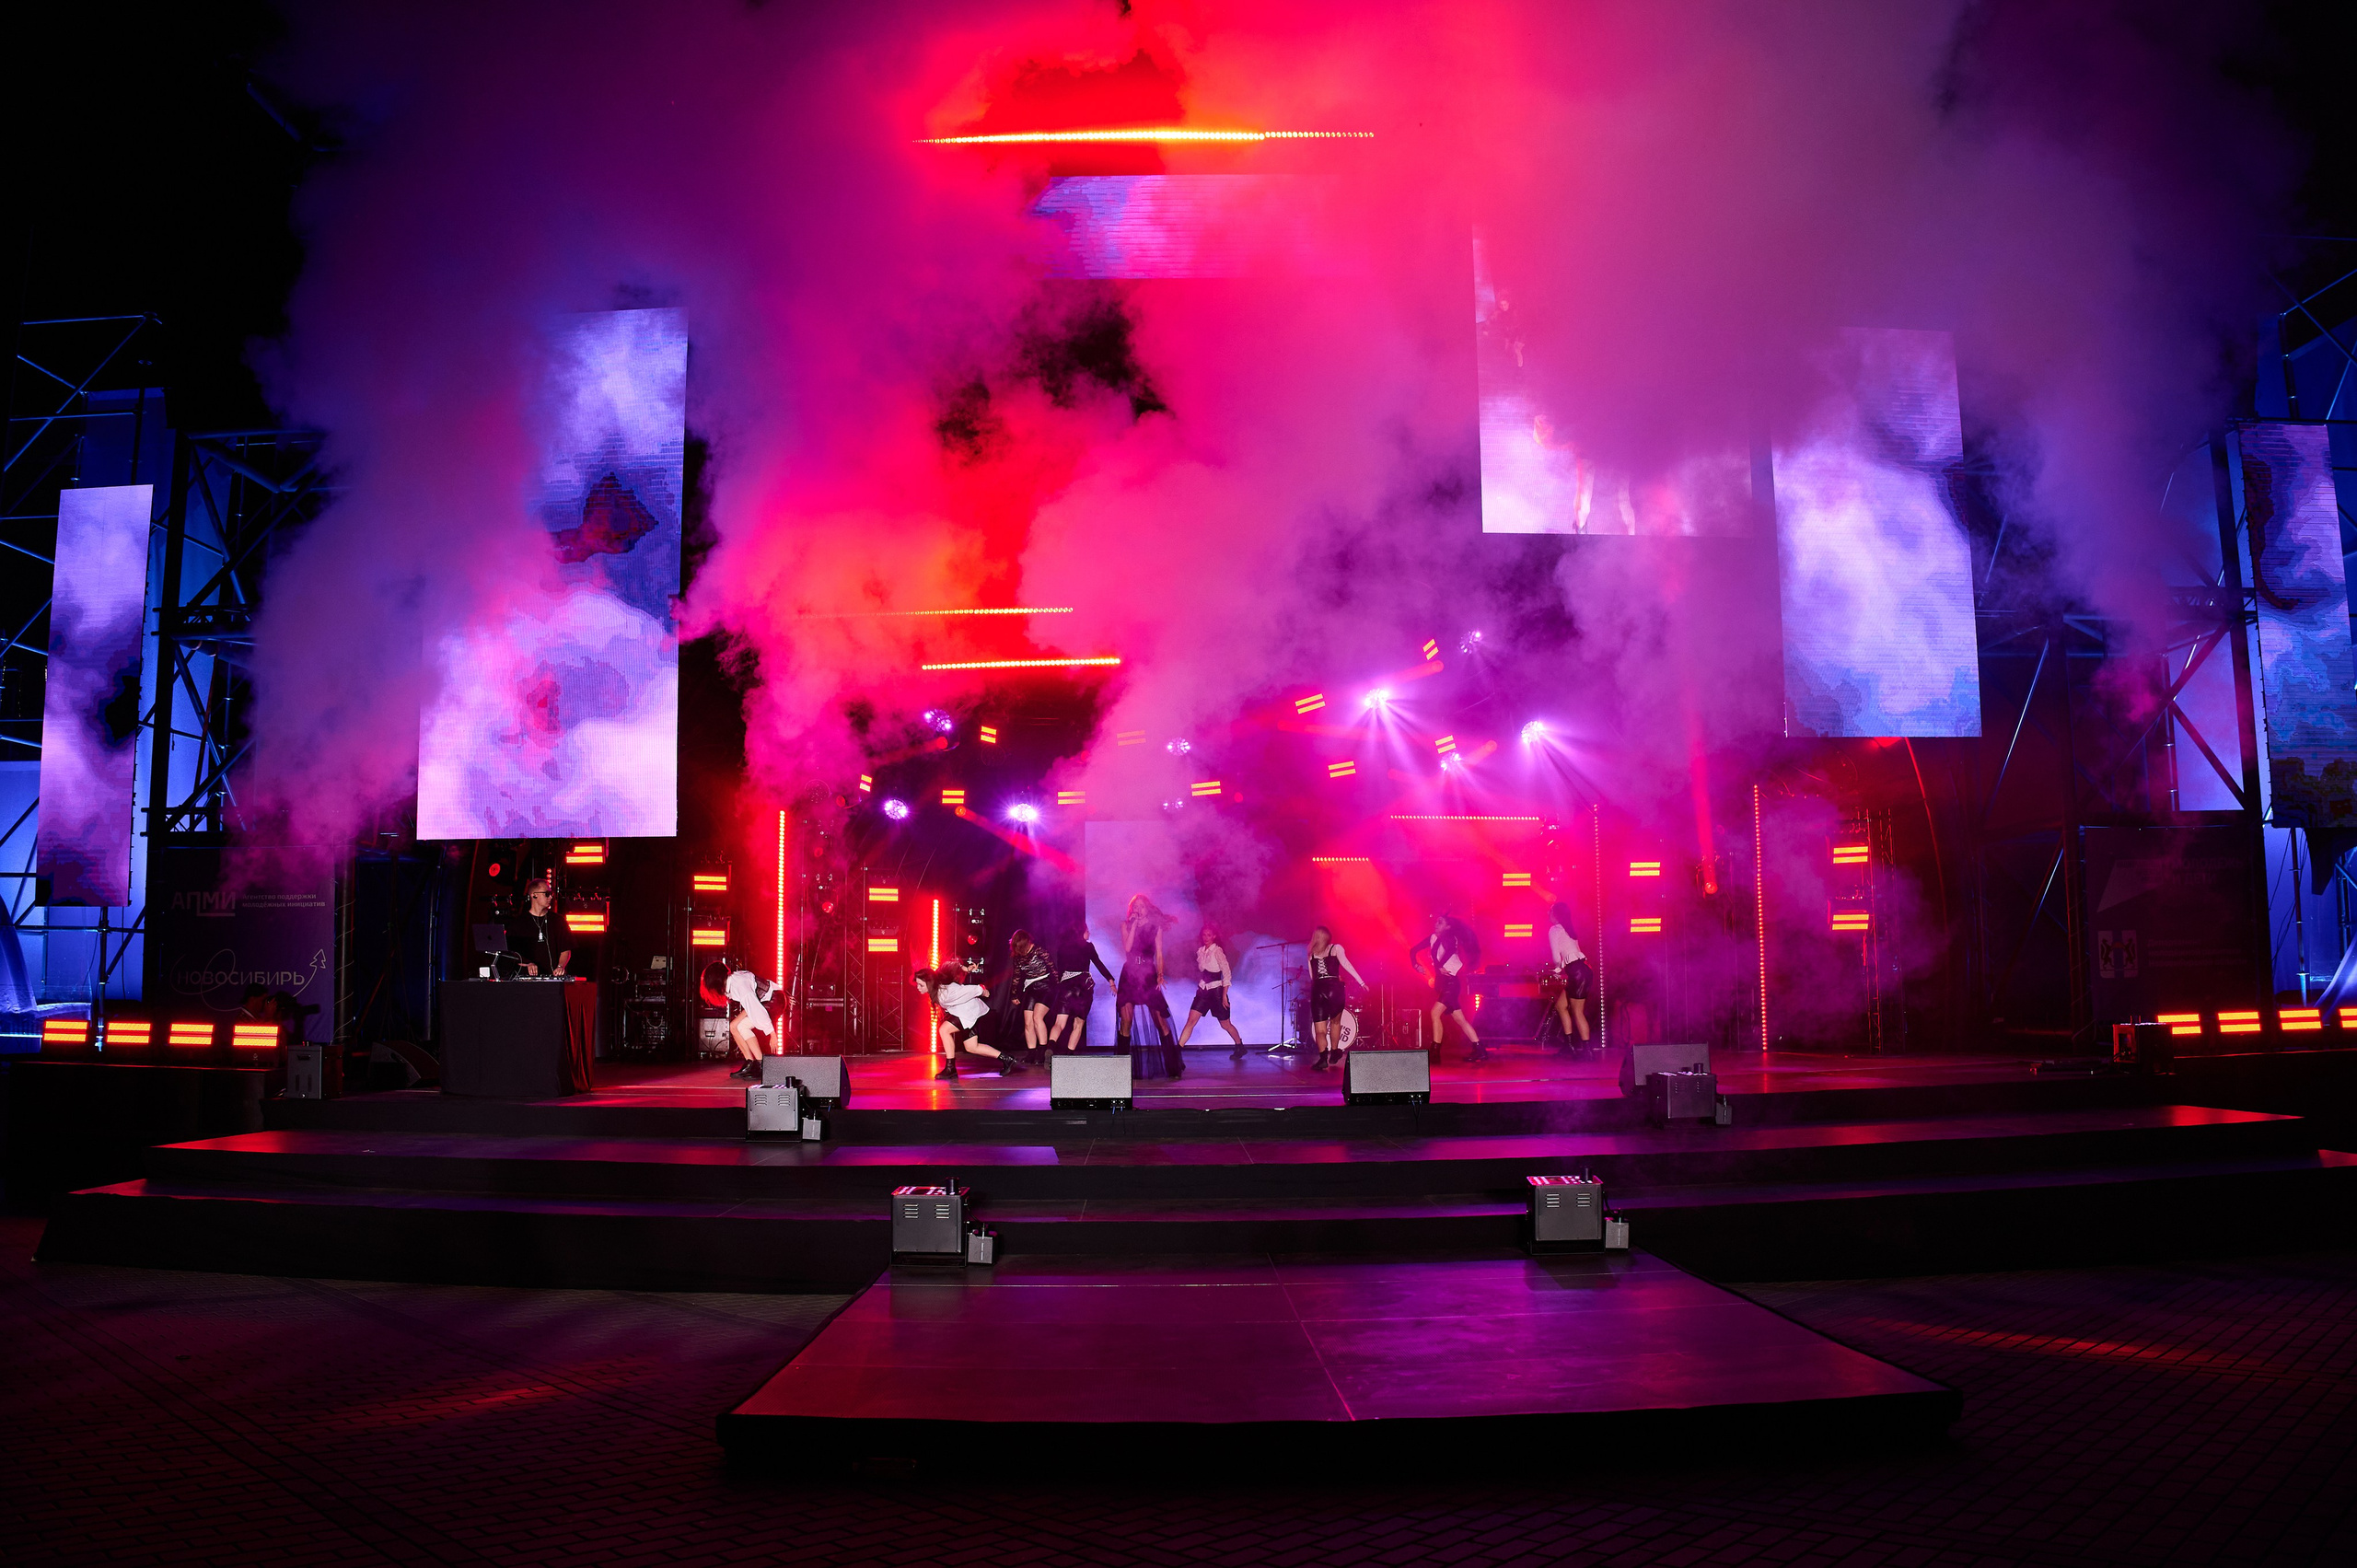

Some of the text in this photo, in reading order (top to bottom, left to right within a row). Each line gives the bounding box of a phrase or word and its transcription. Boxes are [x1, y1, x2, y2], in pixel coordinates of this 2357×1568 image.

[171, 891, 237, 916] АПМИ
[277, 893, 317, 901] поддержки
[177, 970, 305, 986] НОВОСИБИРЬ
